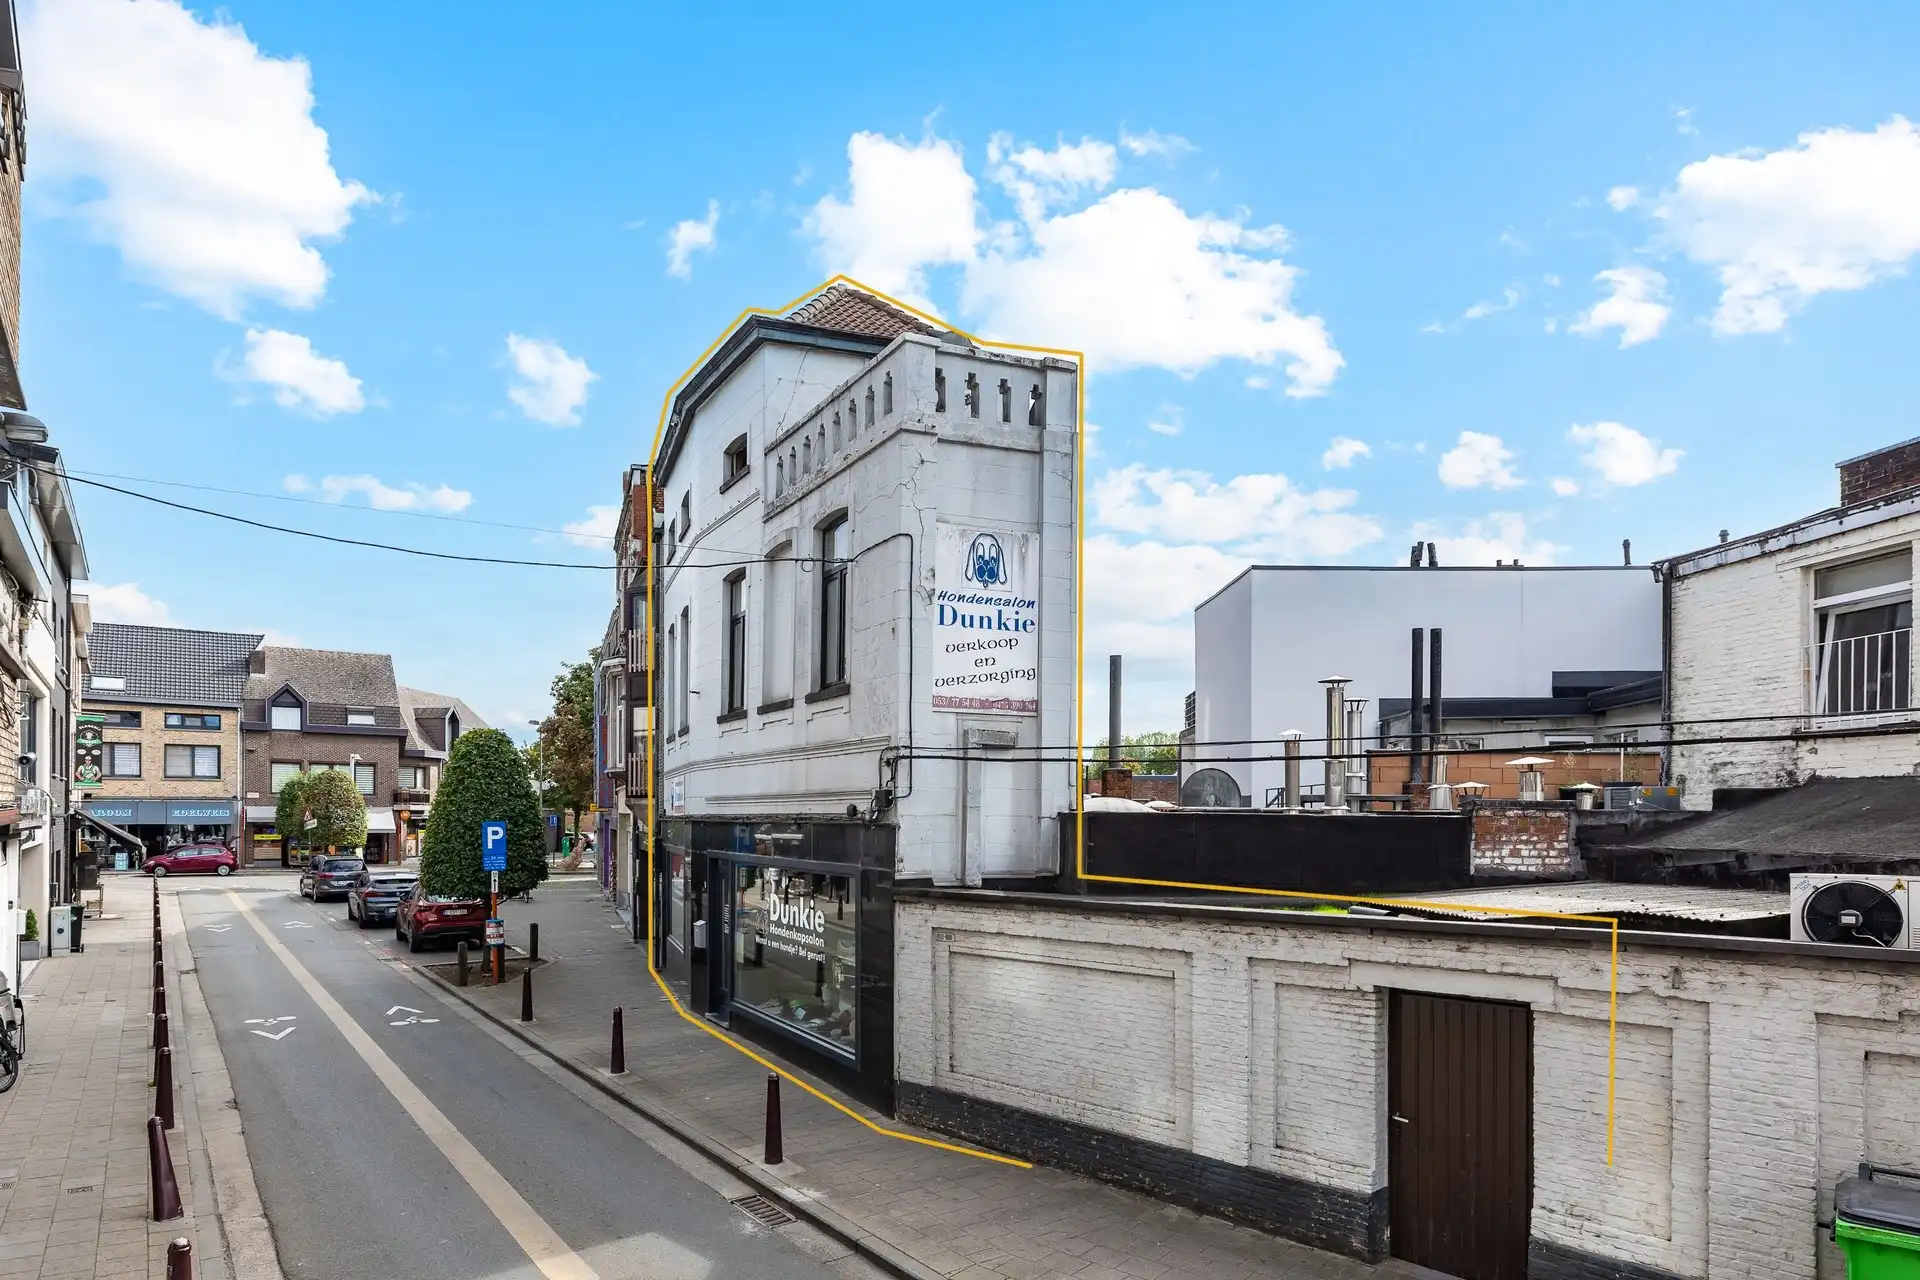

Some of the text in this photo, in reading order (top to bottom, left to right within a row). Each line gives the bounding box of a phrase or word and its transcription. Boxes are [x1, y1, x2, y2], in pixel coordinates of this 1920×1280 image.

[937, 590, 1036, 609] Hondensalon
[937, 604, 1036, 633] Dunkie
[945, 637, 1019, 653] verkoop
[974, 656, 996, 668] en
[934, 667, 1036, 688] verzorging
[487, 826, 504, 849] P
[770, 893, 825, 933] Dunkie
[769, 922, 825, 948] Hondenkapsalon
[799, 946, 807, 957] Bel
